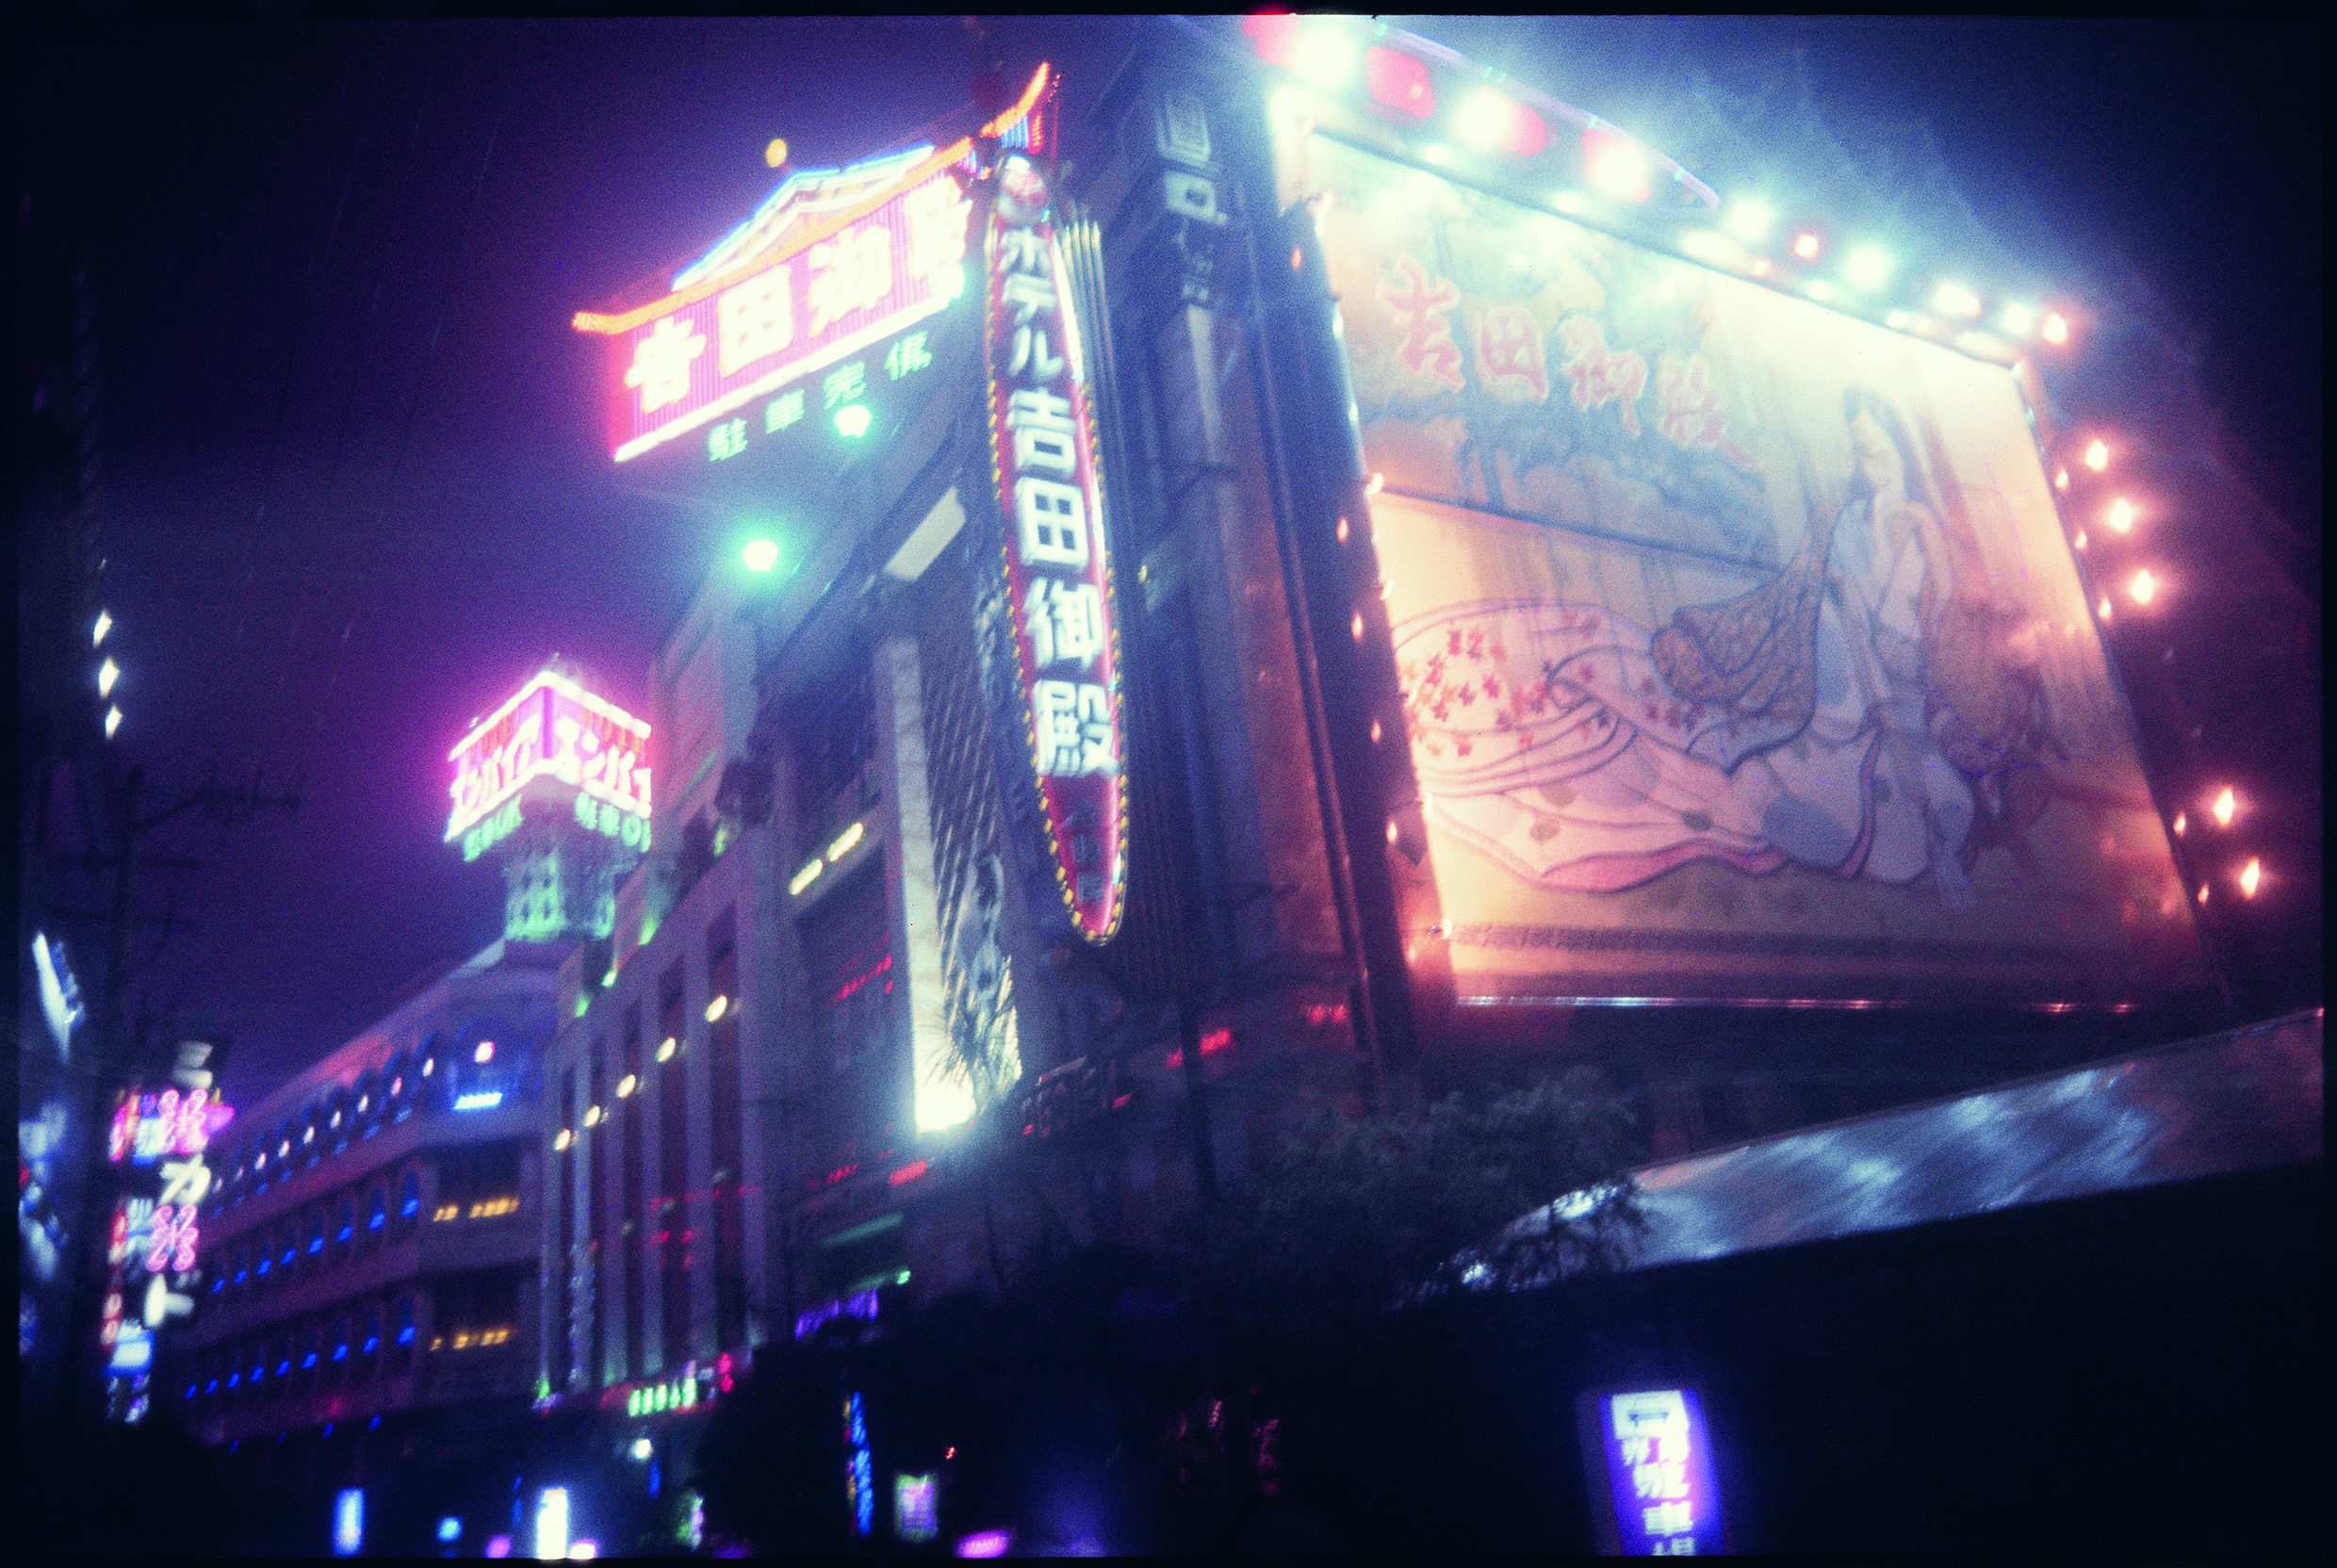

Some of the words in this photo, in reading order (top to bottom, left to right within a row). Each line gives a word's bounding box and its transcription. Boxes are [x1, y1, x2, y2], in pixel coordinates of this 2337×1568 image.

[998, 227, 1118, 777] ホテル吉田御殿
